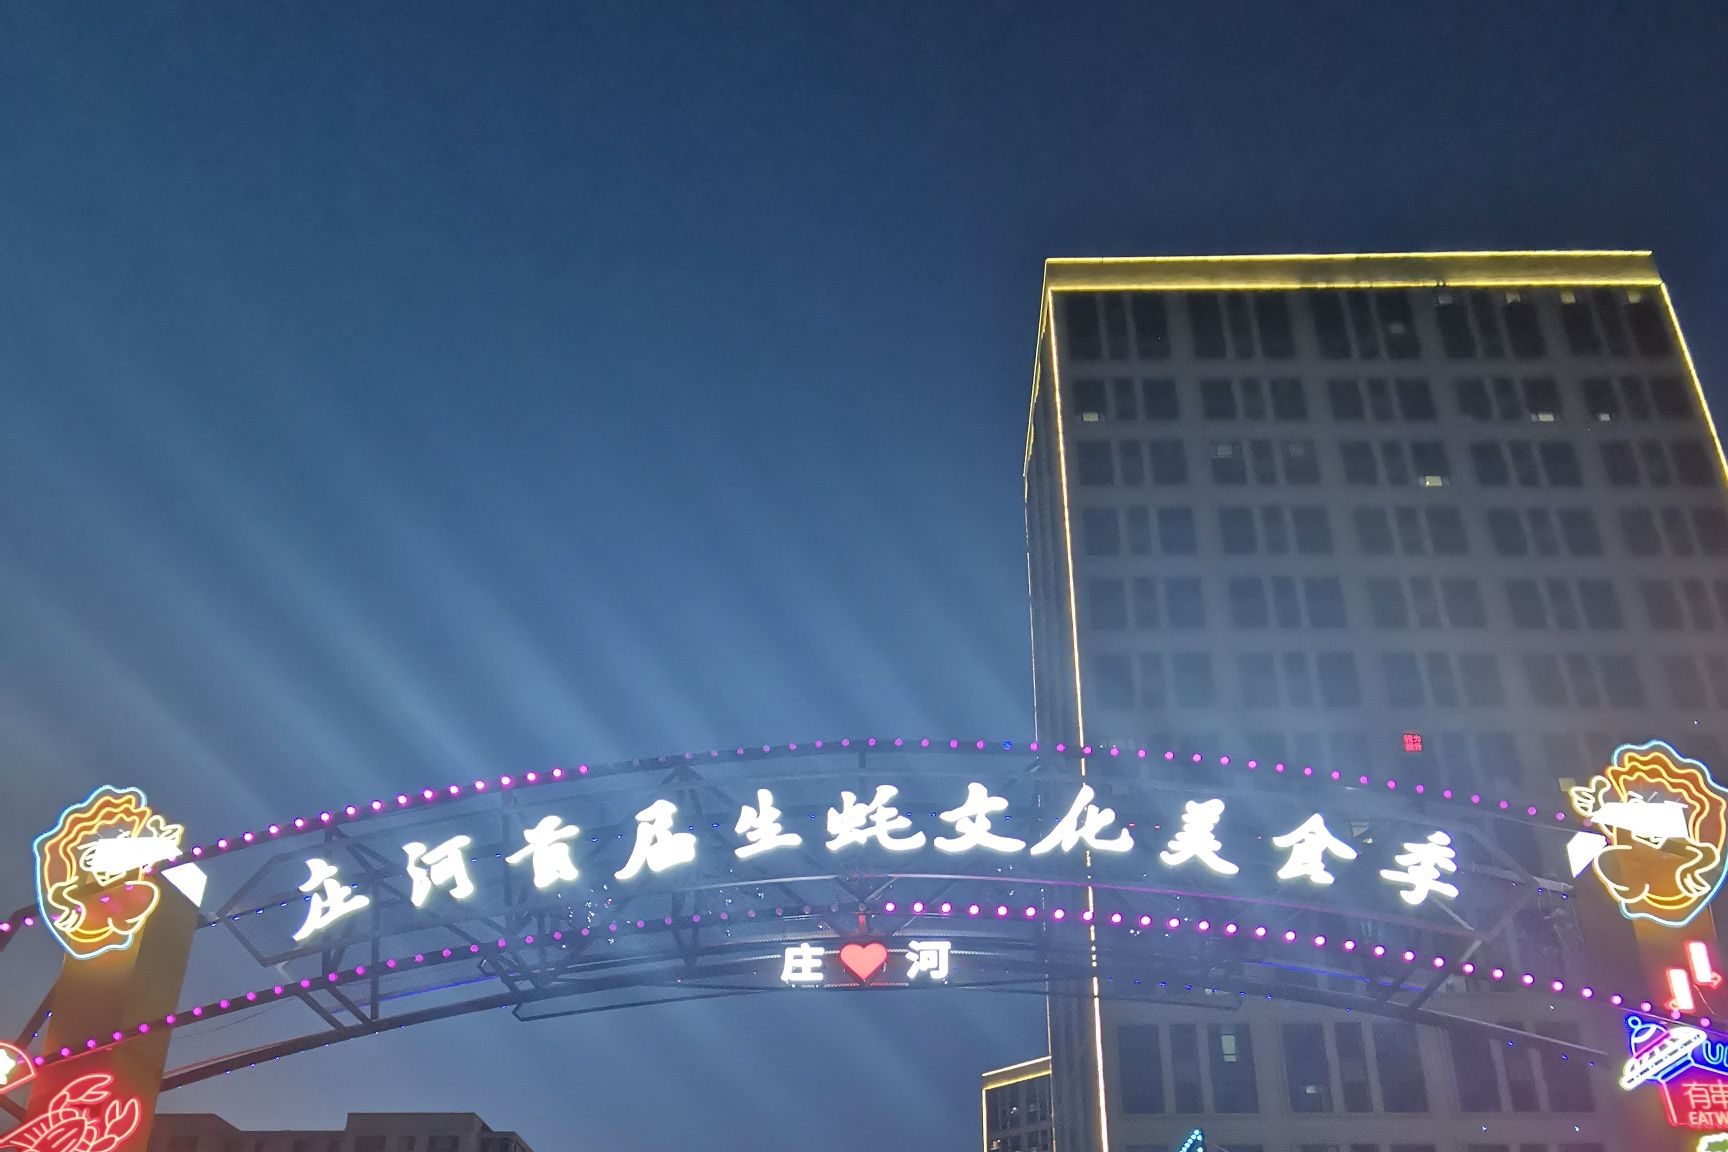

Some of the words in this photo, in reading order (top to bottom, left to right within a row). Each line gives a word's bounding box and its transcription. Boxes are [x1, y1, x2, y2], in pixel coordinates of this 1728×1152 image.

[293, 783, 1459, 941] 庄河首届生蚝文化美食季
[781, 943, 825, 981] 庄
[906, 941, 951, 979] 河
